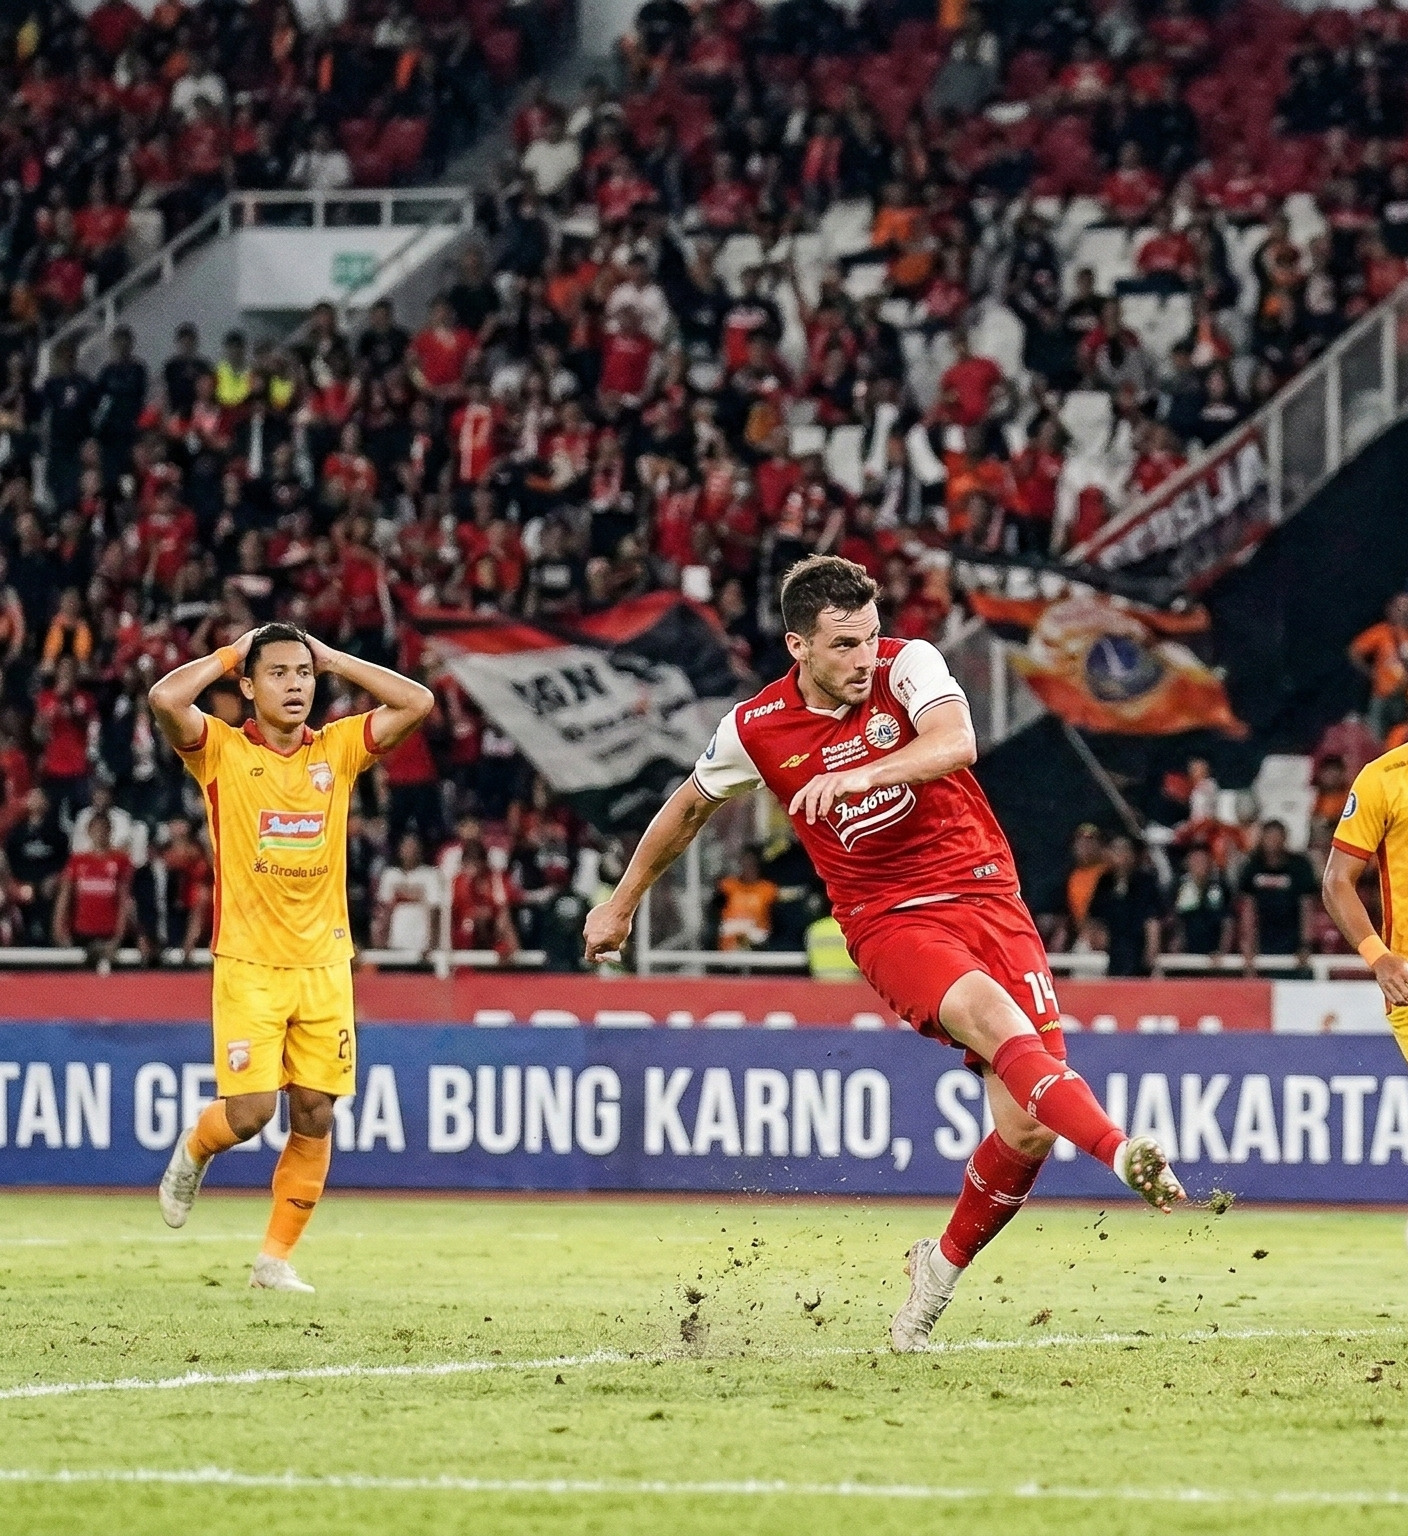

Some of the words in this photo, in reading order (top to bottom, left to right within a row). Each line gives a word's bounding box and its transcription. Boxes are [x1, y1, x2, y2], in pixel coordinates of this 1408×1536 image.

[1023, 971, 1061, 1015] 14
[134, 1061, 406, 1152] GEA
[427, 1064, 622, 1156] BUNG
[643, 1066, 913, 1171] KARNO,
